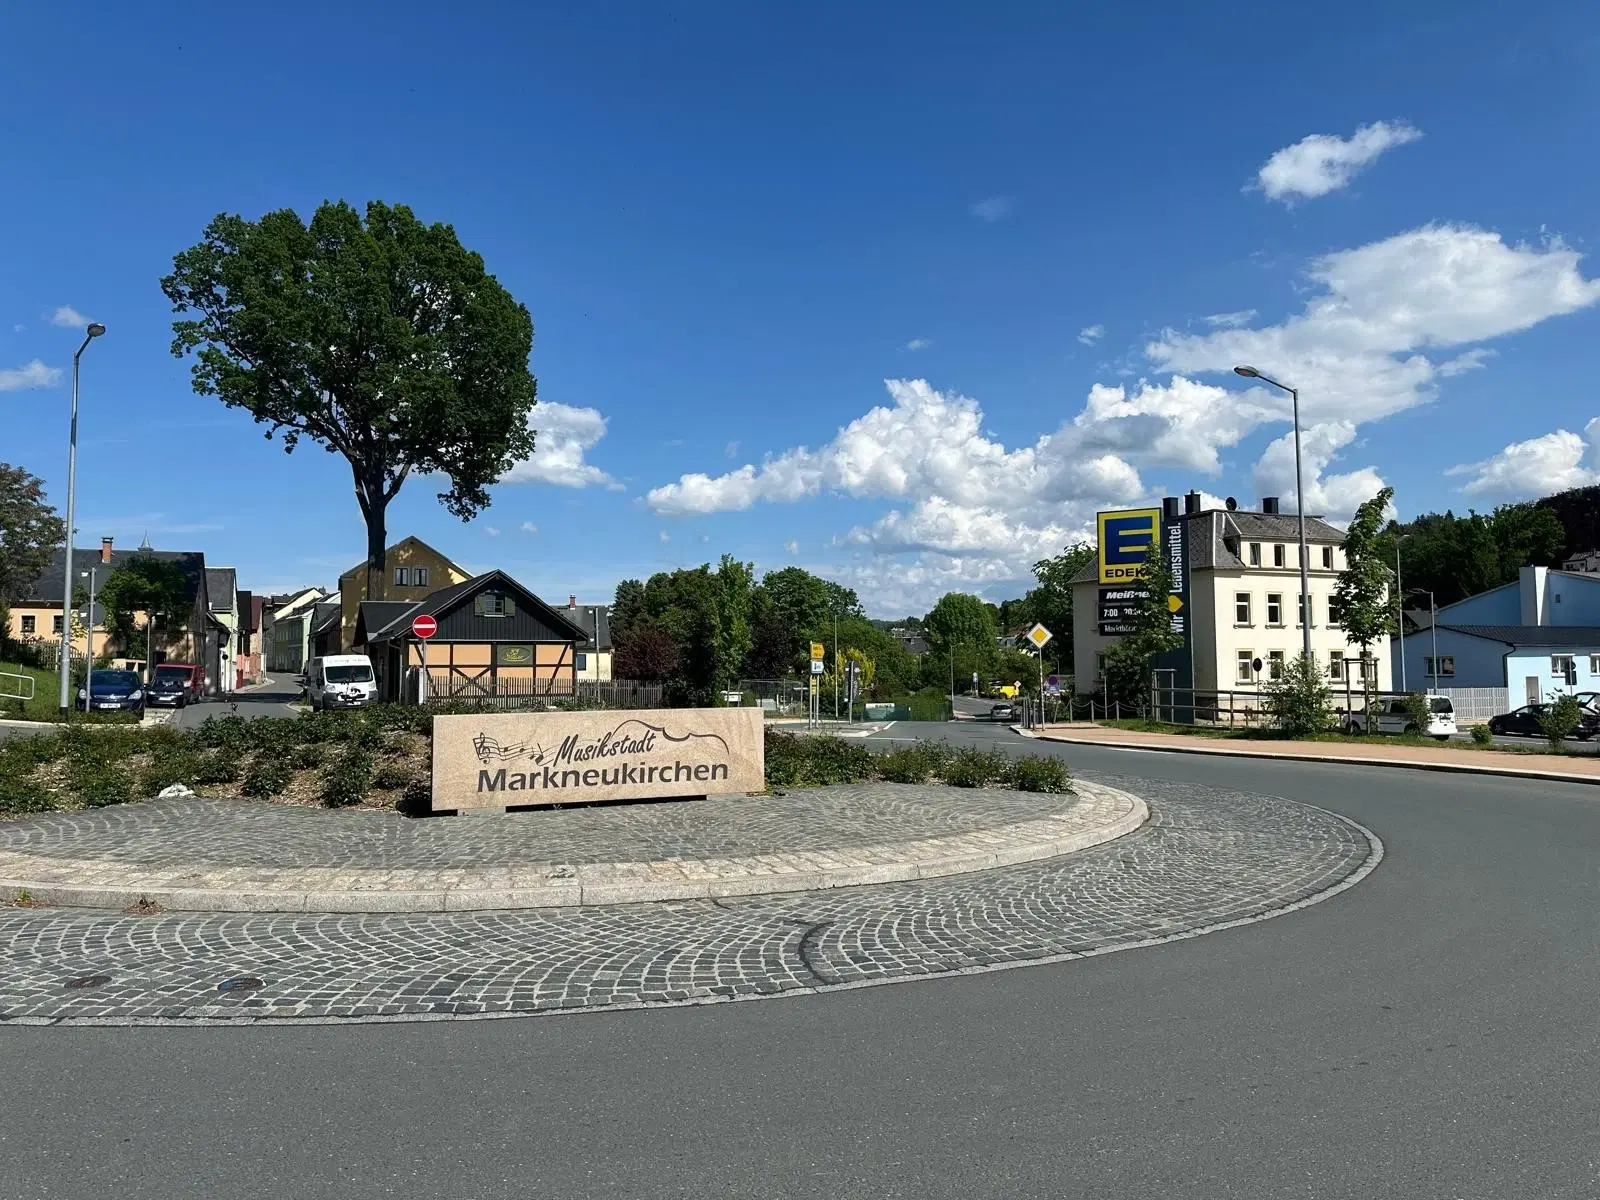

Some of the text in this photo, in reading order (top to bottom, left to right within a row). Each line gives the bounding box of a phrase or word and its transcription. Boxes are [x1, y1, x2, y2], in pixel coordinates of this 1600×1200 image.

[1105, 567, 1147, 578] EDEK
[1167, 522, 1184, 633] Wir Lebensmittel.
[1106, 590, 1151, 600] Meißne
[1103, 608, 1119, 617] 7:00
[553, 729, 656, 767] Musikstadt
[477, 760, 729, 793] Markneukirchen
